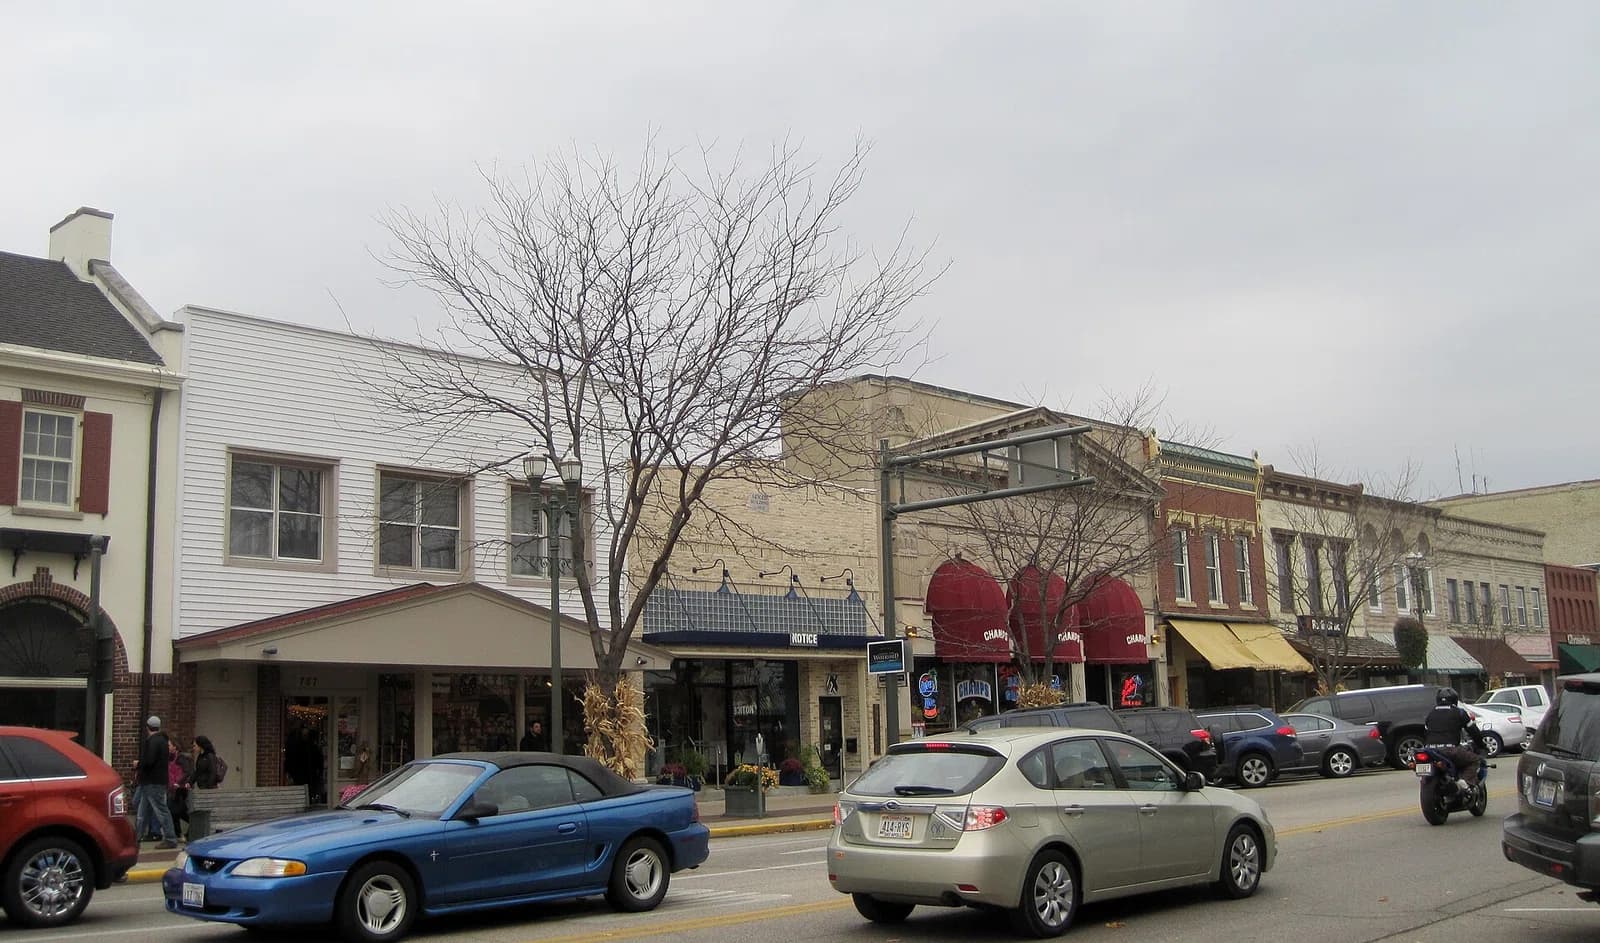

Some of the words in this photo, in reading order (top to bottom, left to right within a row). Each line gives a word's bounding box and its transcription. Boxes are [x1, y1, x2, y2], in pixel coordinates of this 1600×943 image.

[791, 632, 817, 644] NOTICE
[983, 628, 1008, 641] CHAMPS
[959, 681, 990, 699] CHAMPS
